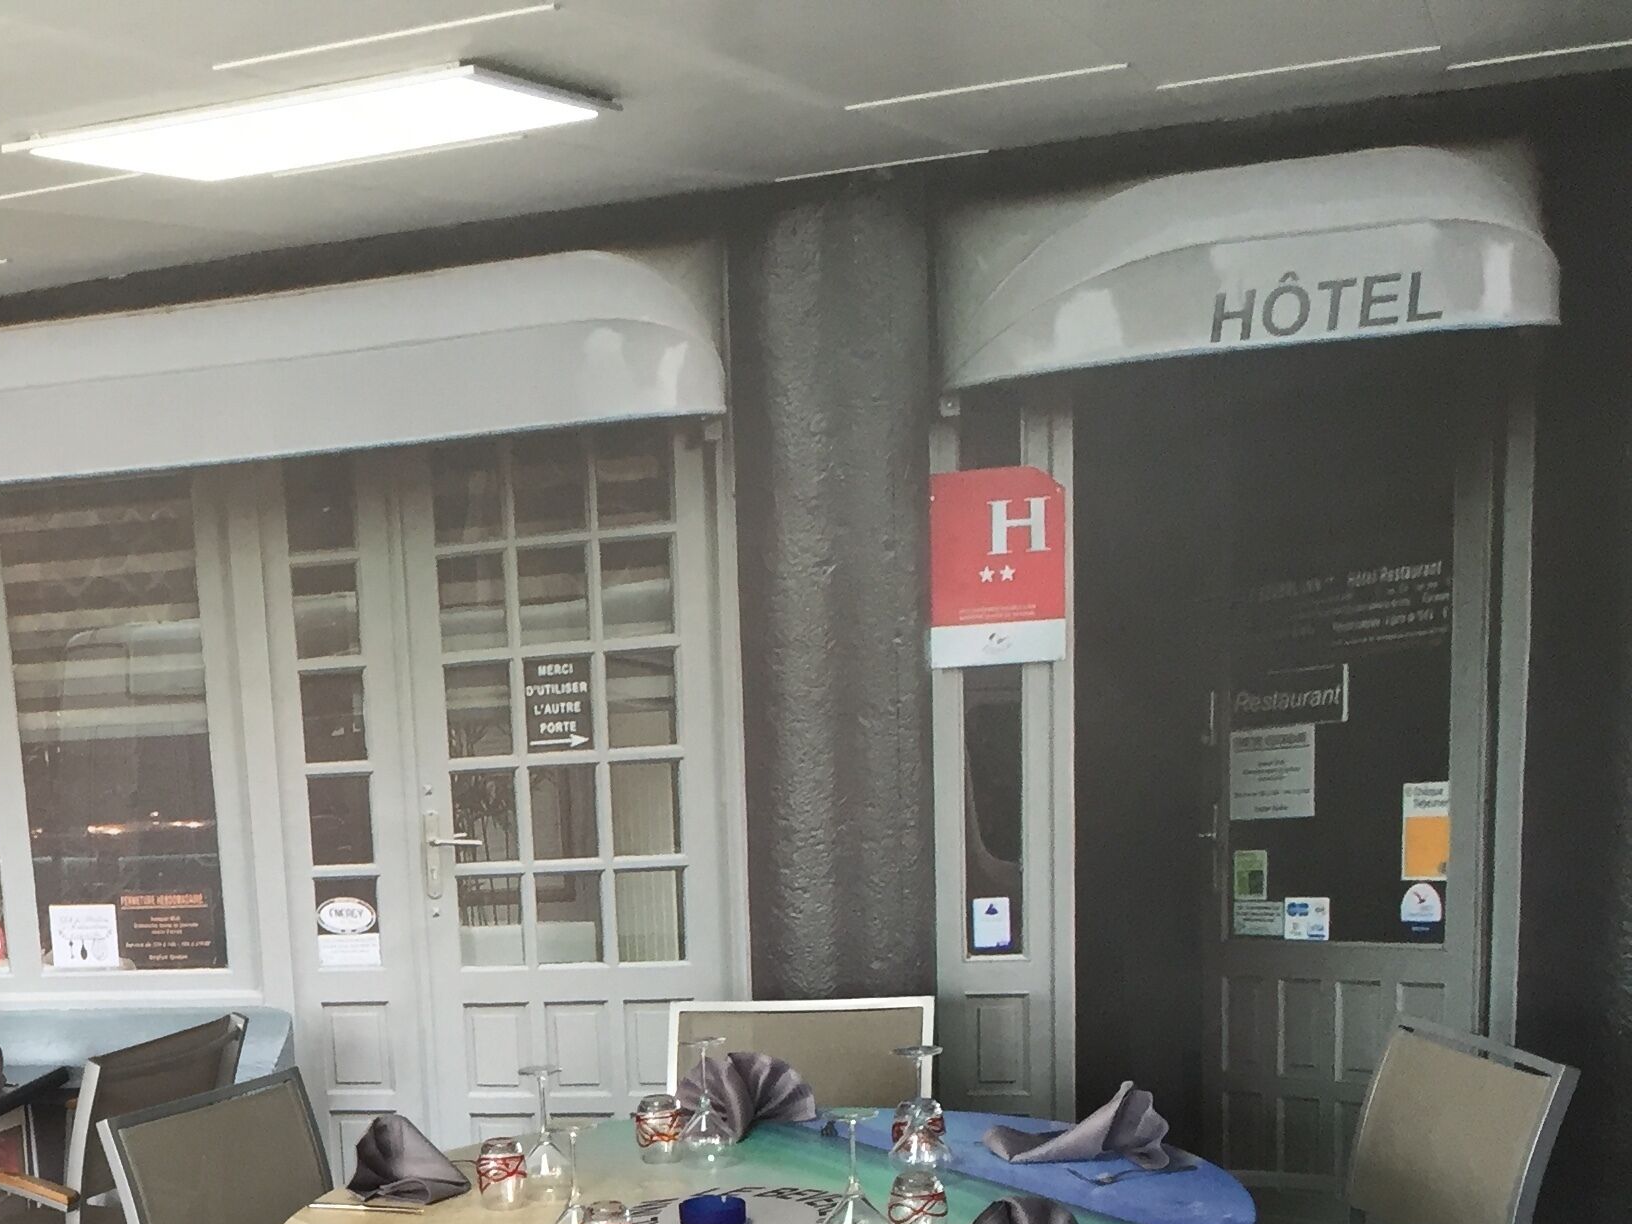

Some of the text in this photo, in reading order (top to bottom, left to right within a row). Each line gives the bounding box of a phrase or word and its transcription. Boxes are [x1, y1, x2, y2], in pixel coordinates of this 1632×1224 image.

[1210, 270, 1444, 344] HÔTEL
[986, 494, 1052, 556] H
[537, 663, 574, 677] MERCI
[526, 681, 588, 697] D'UTILISER
[1233, 683, 1342, 713] Restaurant
[534, 701, 582, 716] L'AUTRE
[540, 720, 577, 734] PORTE
